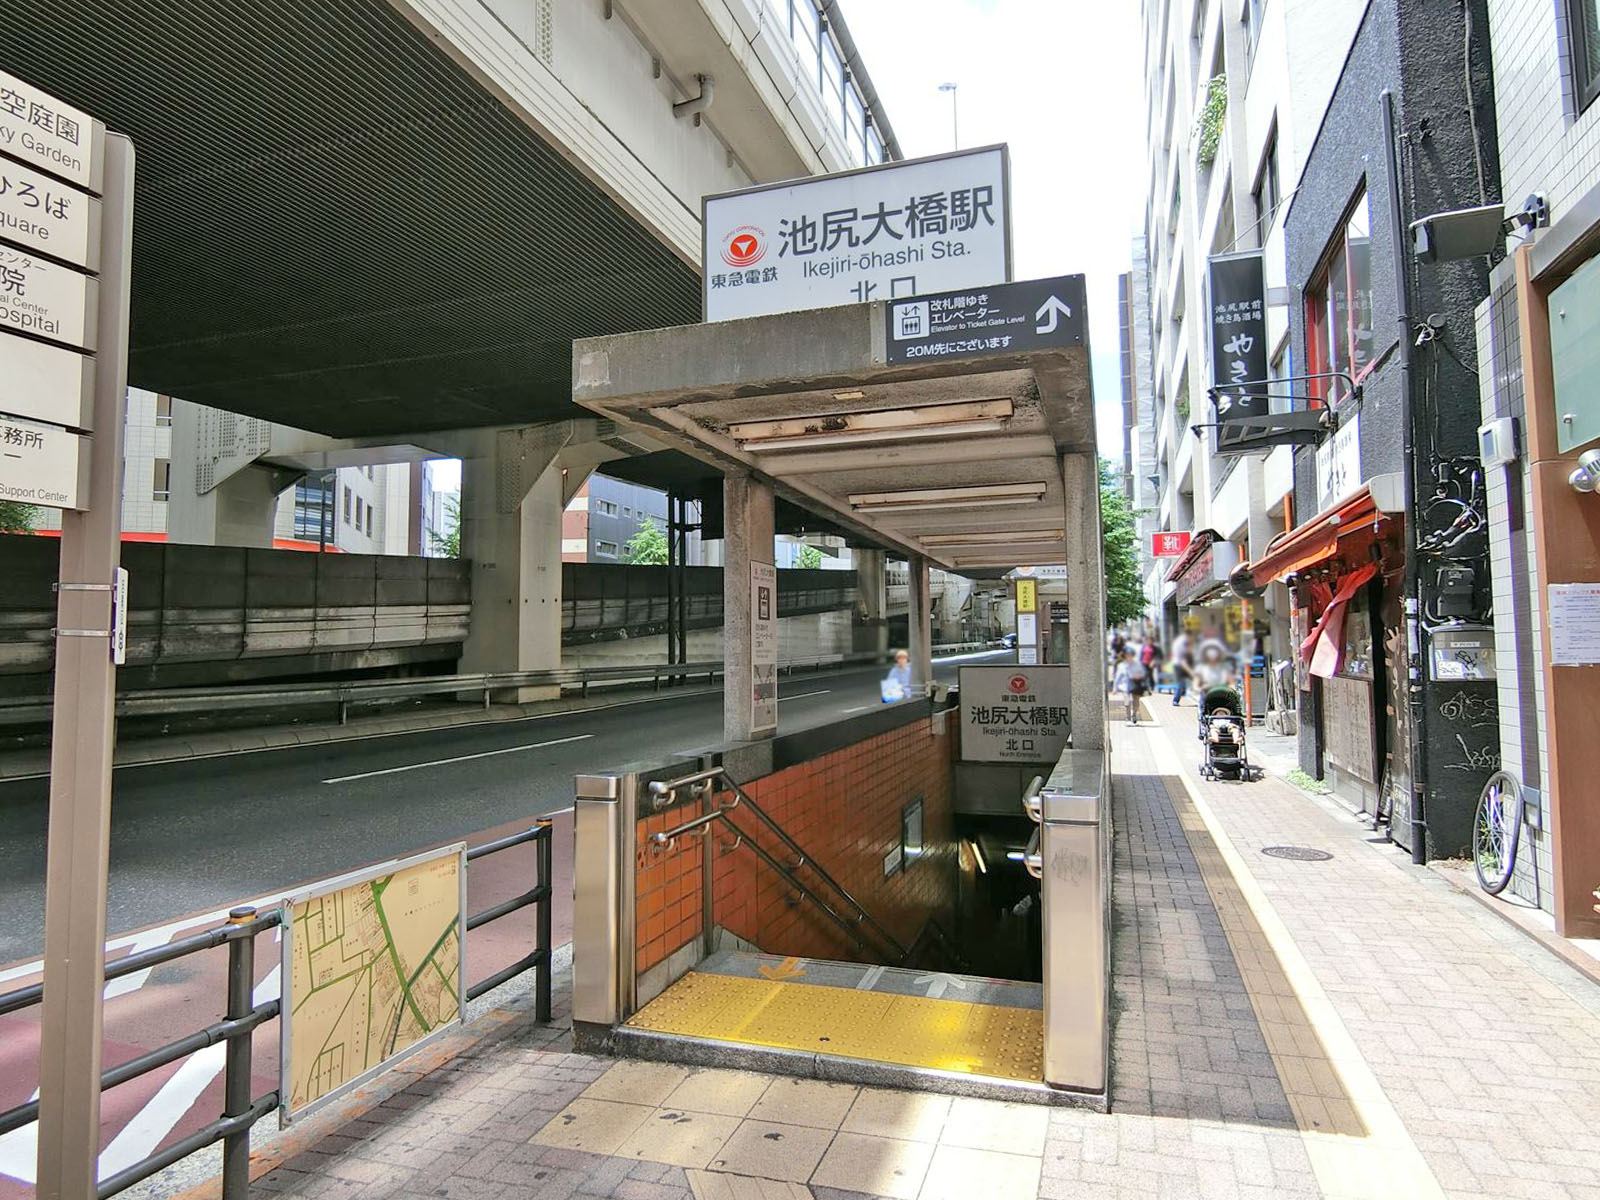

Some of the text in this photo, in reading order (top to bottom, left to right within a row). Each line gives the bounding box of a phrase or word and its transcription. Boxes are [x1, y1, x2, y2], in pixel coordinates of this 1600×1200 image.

[0, 88, 80, 146] 空庭園
[21, 132, 81, 171] Garden
[778, 185, 996, 259] 池尻大橋駅
[803, 240, 971, 281] Ikejiri-ōhashi Sta.
[711, 266, 778, 290] 東急電鉄
[12, 297, 48, 315] Center
[930, 294, 989, 312] 改札階ゆき
[931, 304, 1000, 325] エレベーター
[931, 315, 1026, 334] Elevator to Ticket Gate Level
[906, 335, 1012, 358] 20M先にございます
[0, 425, 44, 450] 務所
[38, 489, 68, 502] Center
[971, 706, 1069, 726] 池尻大橋駅
[1006, 739, 1034, 751] 北口
